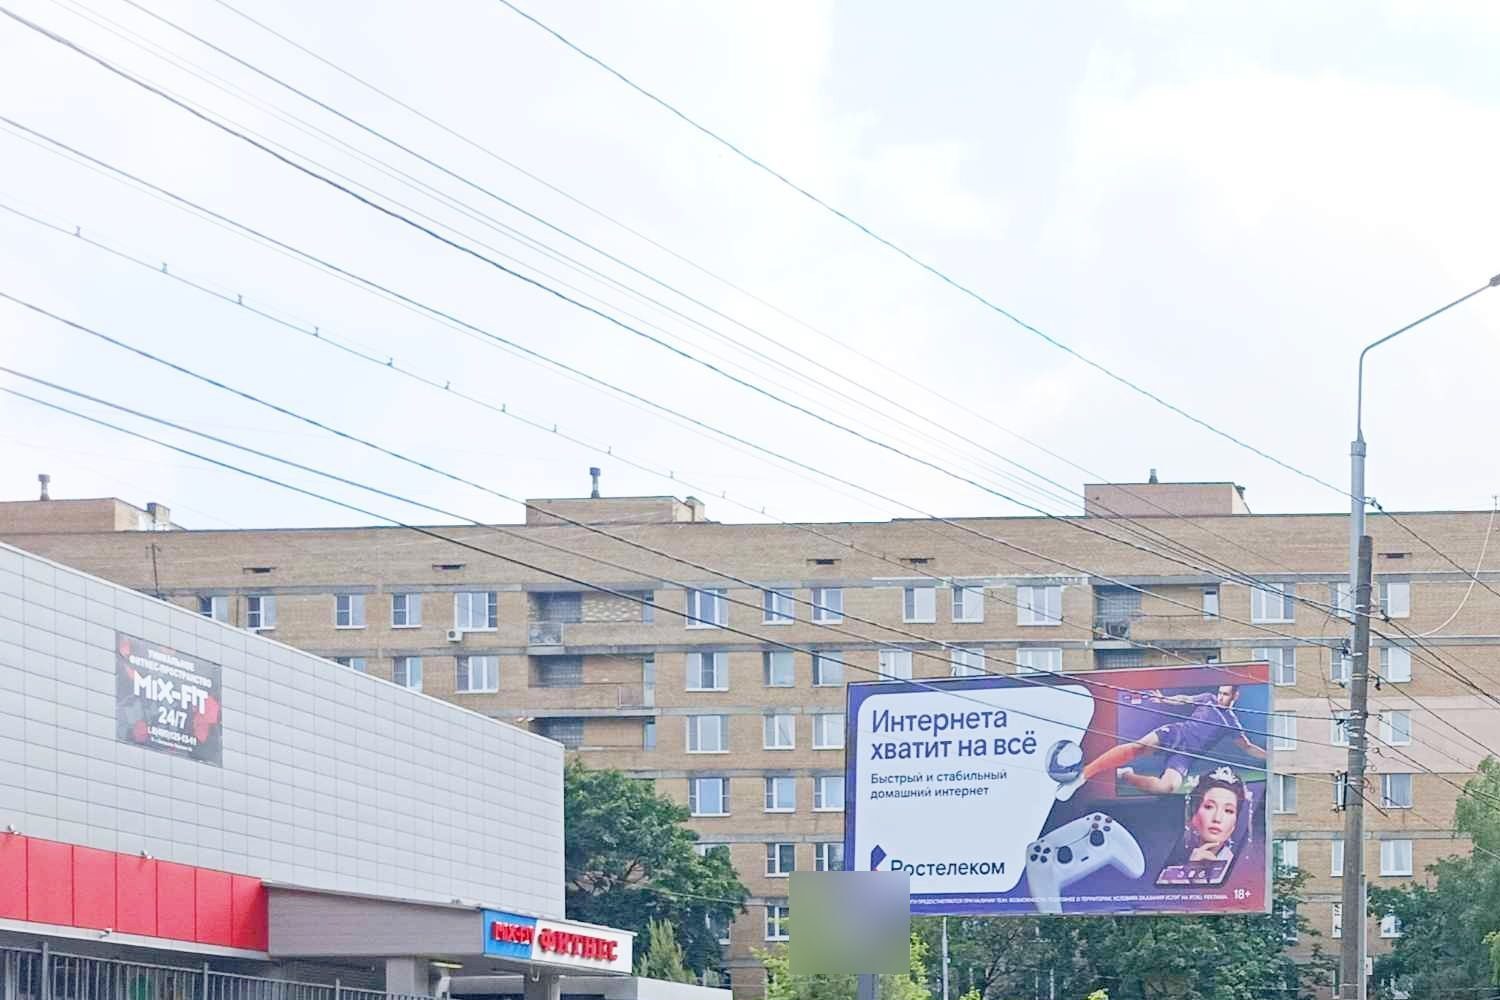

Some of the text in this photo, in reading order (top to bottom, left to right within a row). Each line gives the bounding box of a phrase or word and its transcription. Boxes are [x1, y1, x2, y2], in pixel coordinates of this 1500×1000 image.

[158, 705, 188, 730] 24/7
[872, 709, 1007, 737] Интернета
[870, 730, 1037, 760] хватит на всё
[871, 769, 1008, 785] Быстрый и стабильный
[870, 786, 990, 800] домашний интернет
[890, 859, 1006, 877] Ростелеком
[1233, 888, 1252, 901] 18+
[537, 927, 618, 962] ФИТНЕС
